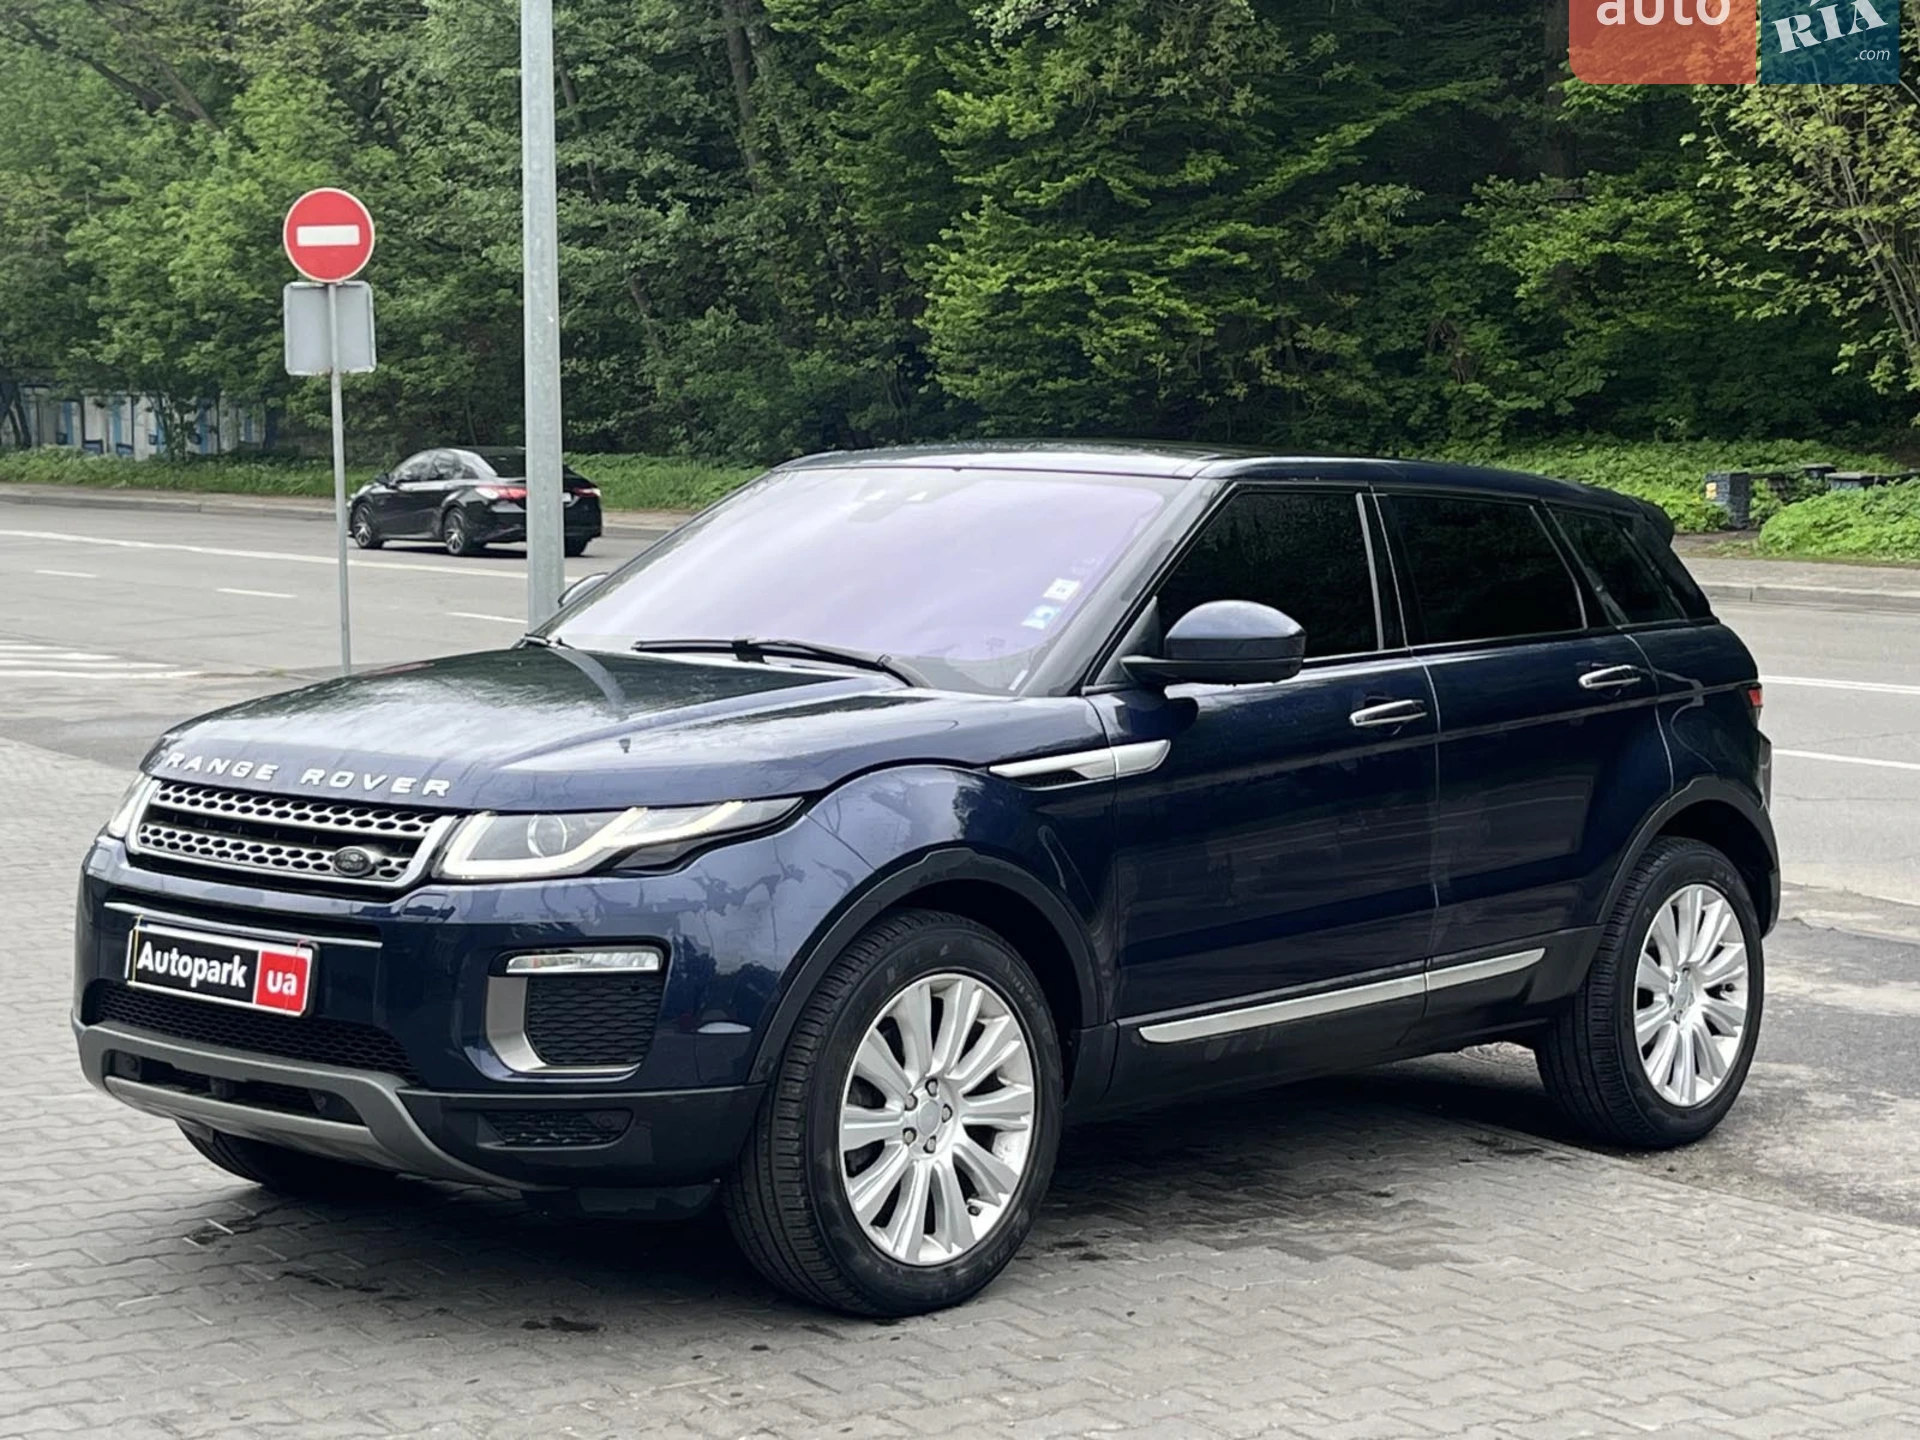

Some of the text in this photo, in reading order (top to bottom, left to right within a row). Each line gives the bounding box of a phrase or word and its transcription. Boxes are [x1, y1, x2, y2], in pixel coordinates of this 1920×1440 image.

[164, 752, 450, 797] RANGE ROVER
[137, 941, 298, 996] Autopark ua
